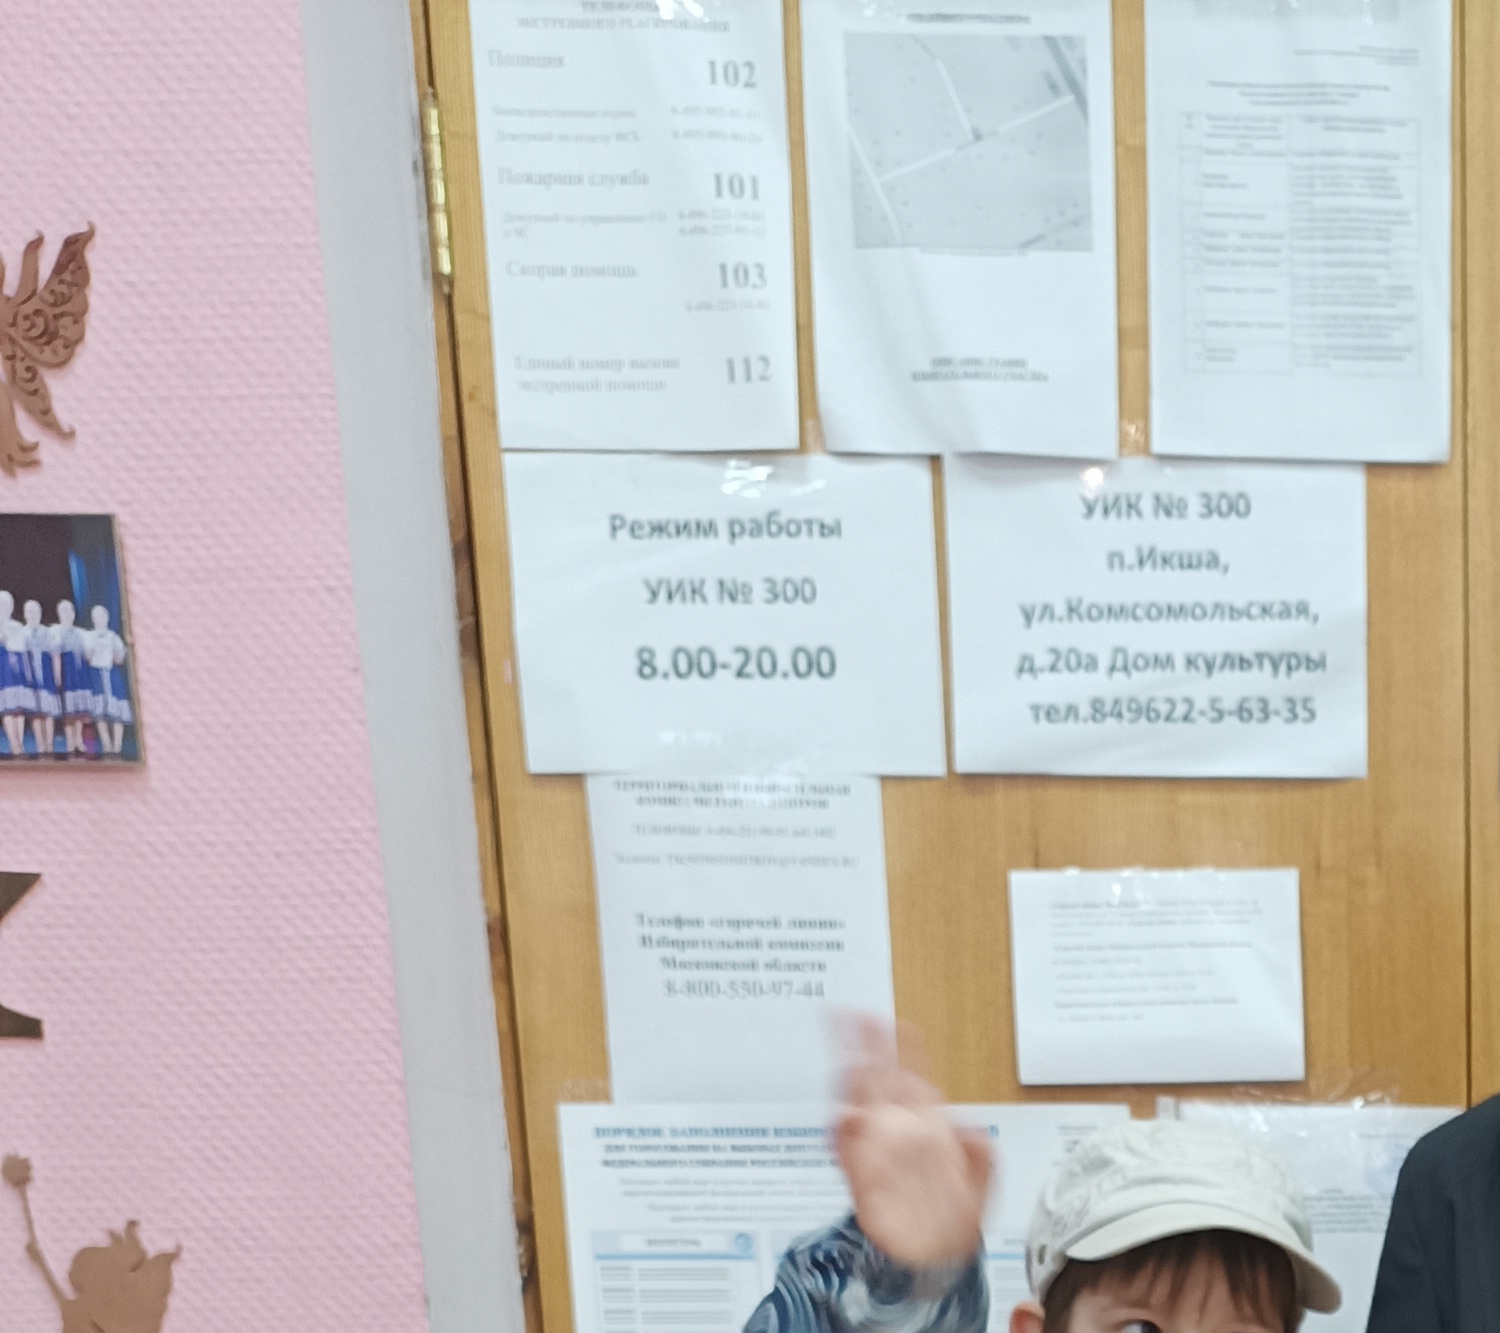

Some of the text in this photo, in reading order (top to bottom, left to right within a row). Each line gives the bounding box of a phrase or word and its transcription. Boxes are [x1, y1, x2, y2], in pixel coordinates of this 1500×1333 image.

[706, 60, 758, 89] 102
[712, 172, 761, 201] 101
[718, 261, 768, 290] 103
[726, 354, 772, 385] 112
[1080, 492, 1252, 520] УИК № 300
[609, 510, 843, 545] Режим работы
[1107, 546, 1230, 576] п.Икша,
[642, 577, 817, 605] УИК № 300
[1019, 598, 1319, 629] ул.Комсомольская,
[636, 646, 838, 681] 8.00-20.00
[1016, 648, 1328, 680] д.20а Дом культуры
[1029, 696, 1317, 725] тел.849622-5-63-35
